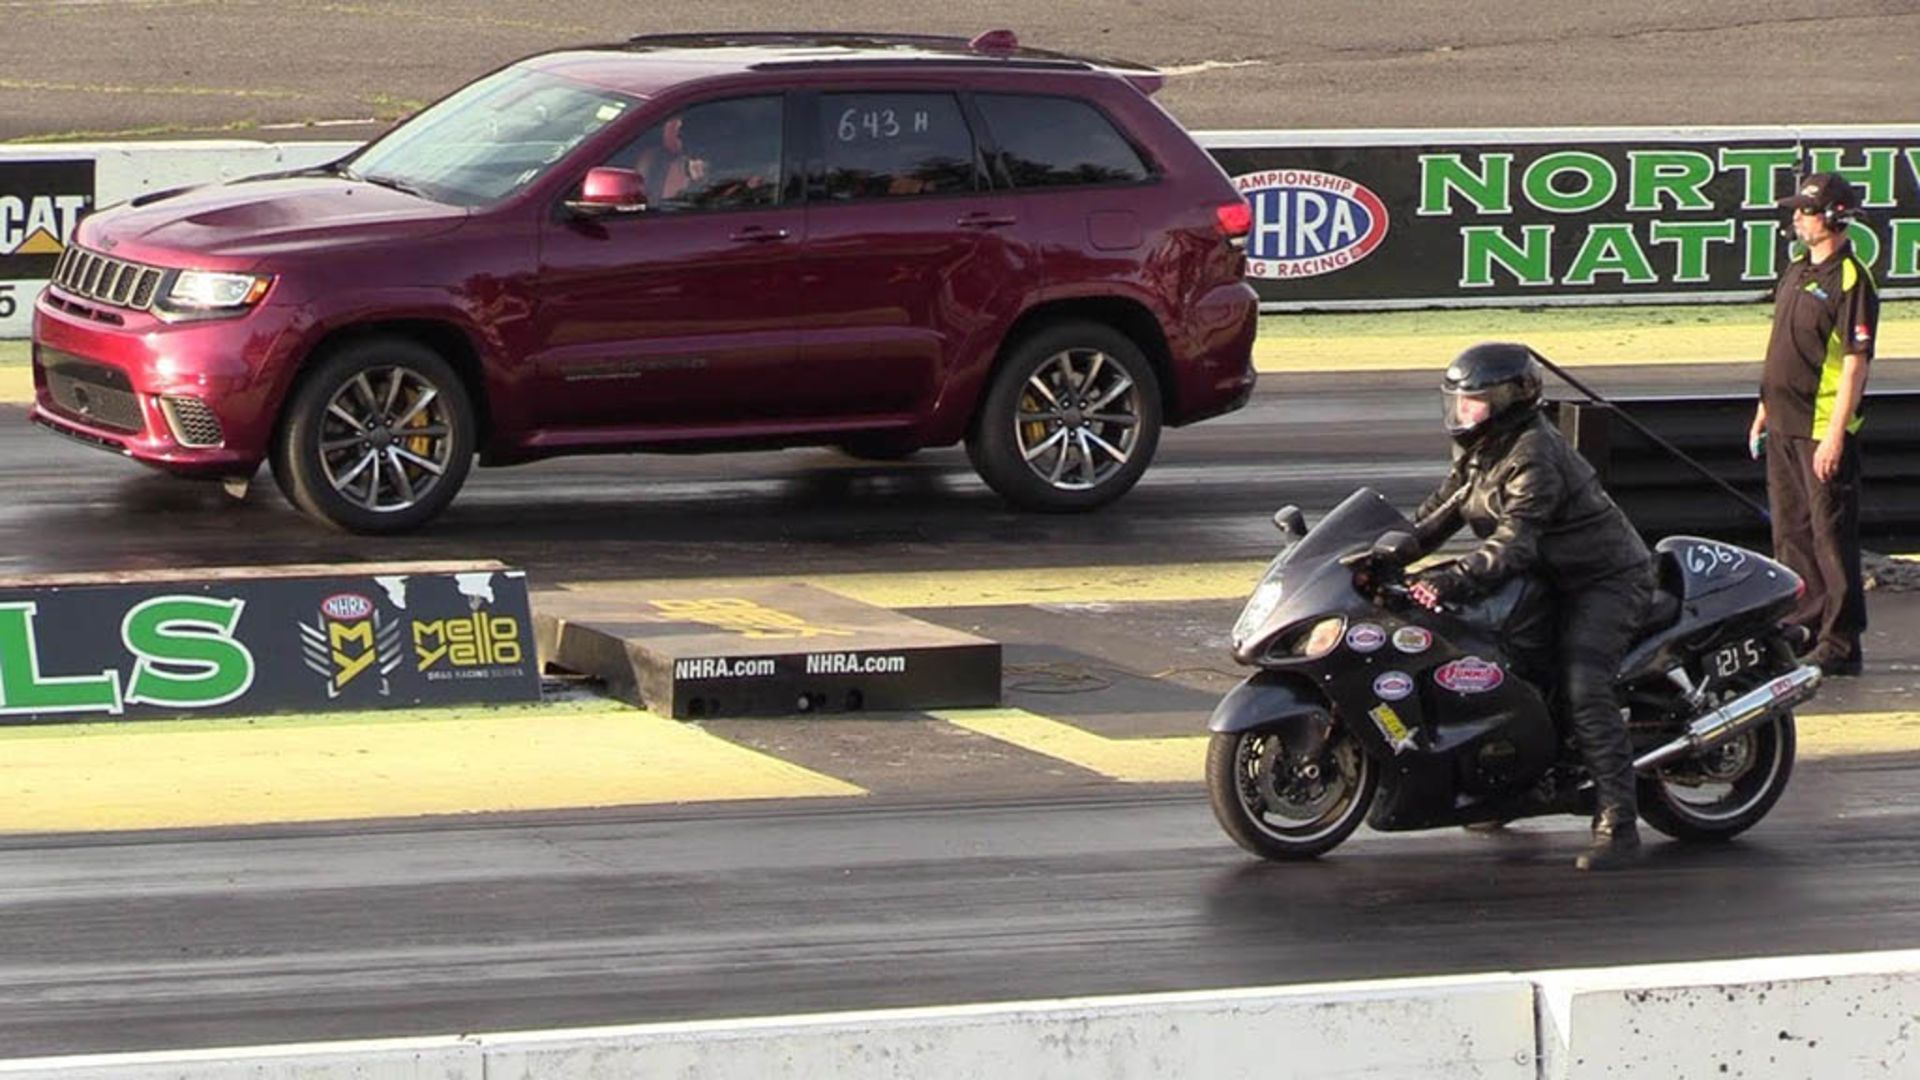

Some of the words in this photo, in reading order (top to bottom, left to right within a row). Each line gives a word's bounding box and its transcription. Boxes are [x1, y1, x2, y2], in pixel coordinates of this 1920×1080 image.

[838, 108, 900, 141] 643
[1238, 172, 1351, 191] AMPIONSHIP
[1417, 146, 1920, 215] NORTH
[0, 195, 84, 255] CAT
[1278, 252, 1349, 277] RACING
[328, 597, 367, 617] NHRA
[675, 659, 776, 679] NHRA.com
[806, 654, 905, 674] NHRA.com
